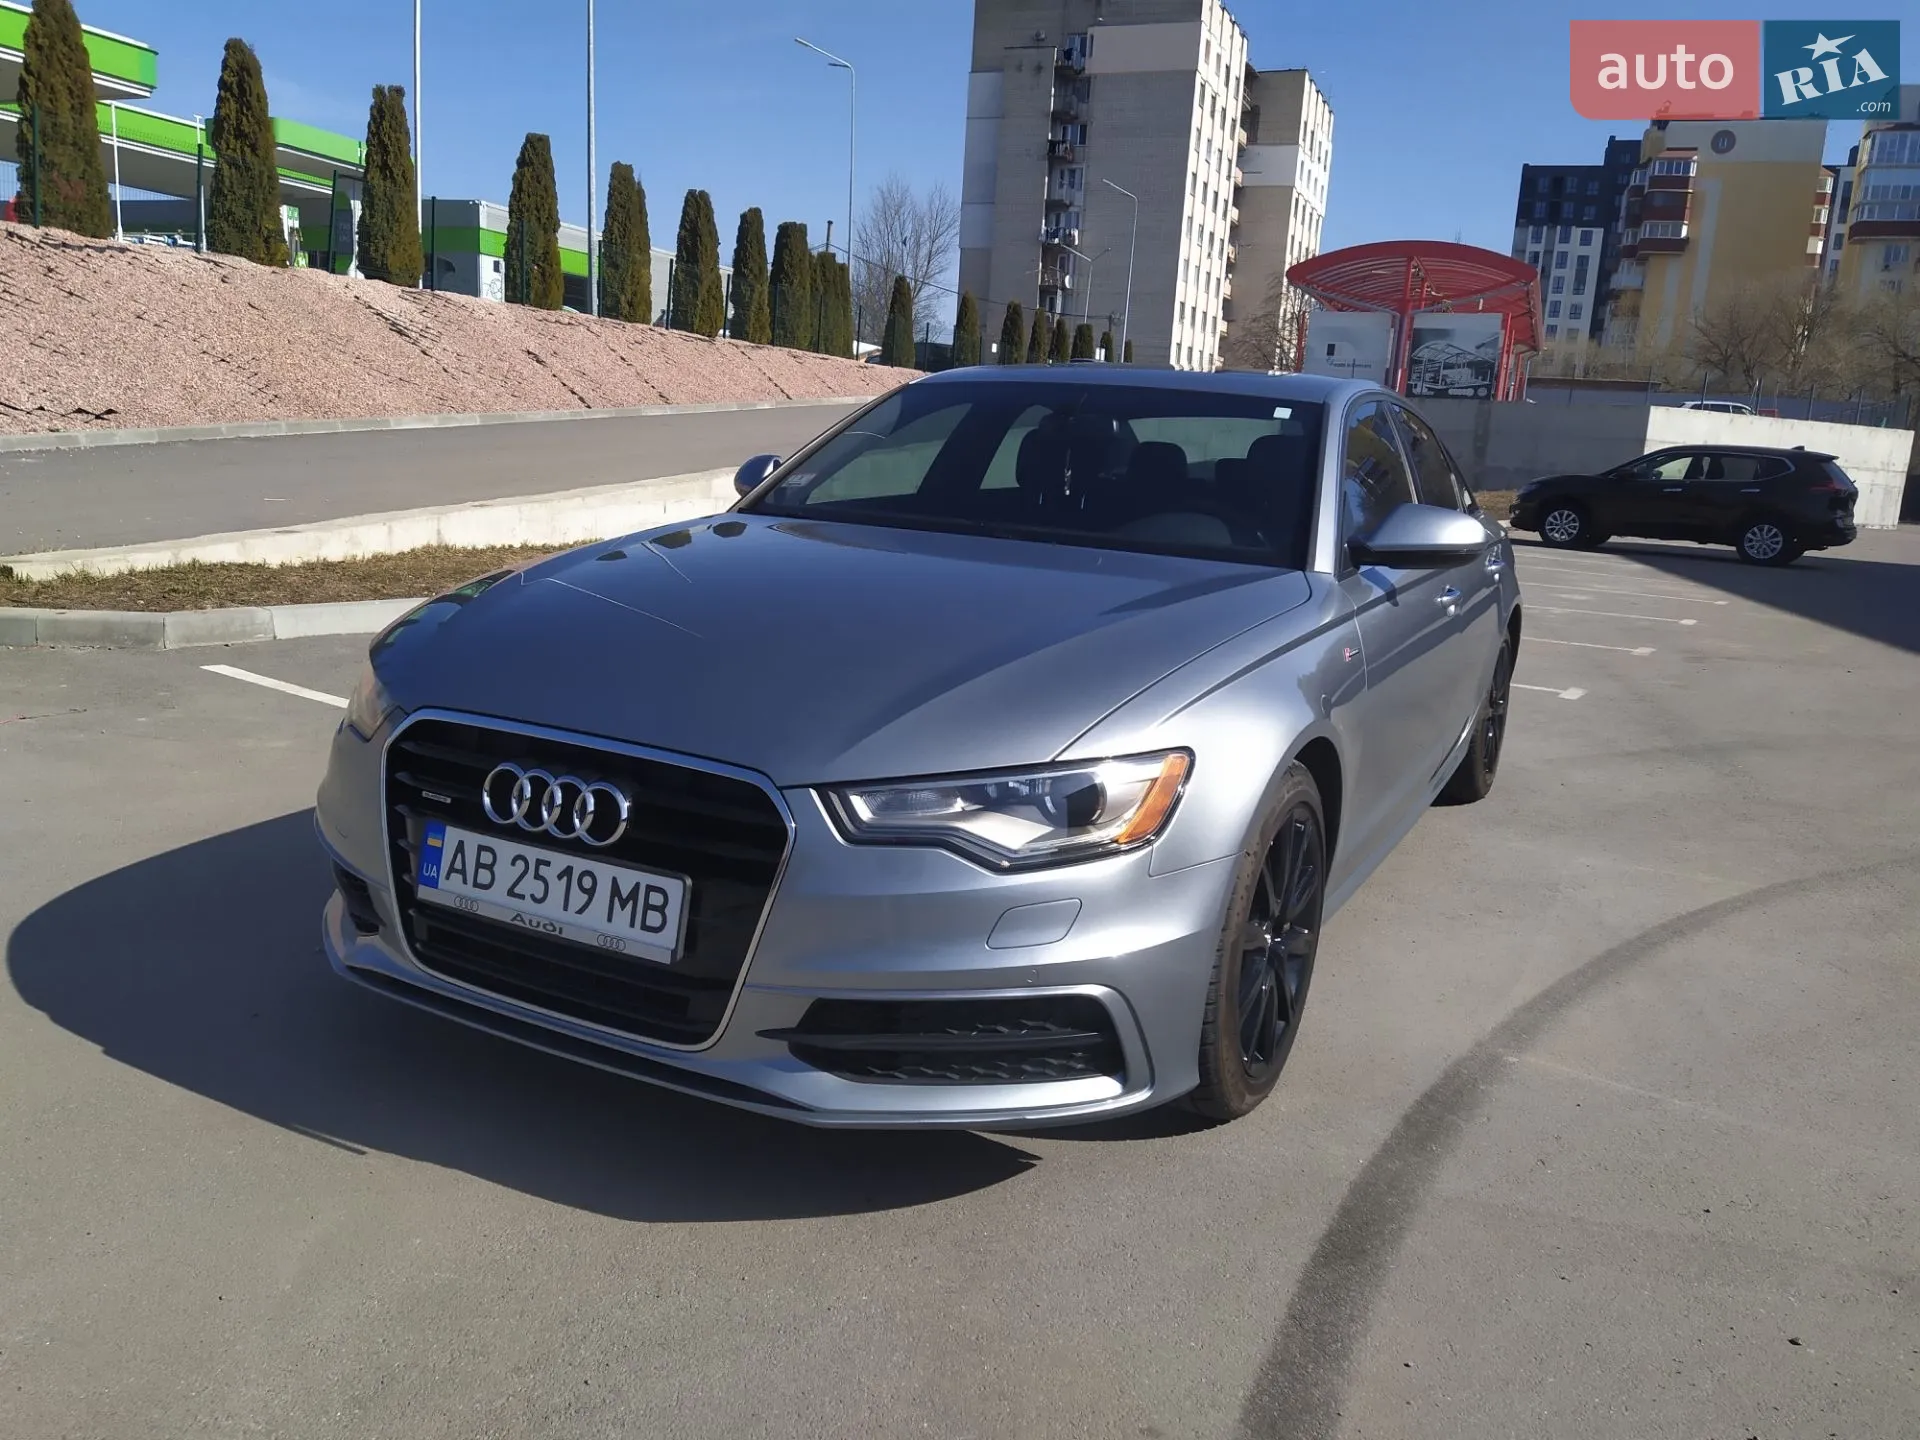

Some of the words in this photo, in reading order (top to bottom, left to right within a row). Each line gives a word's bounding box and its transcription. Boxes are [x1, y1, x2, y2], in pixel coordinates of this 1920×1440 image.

[423, 862, 438, 879] UA
[445, 840, 497, 890] AB
[506, 854, 598, 915] 2519
[607, 876, 670, 934] MB
